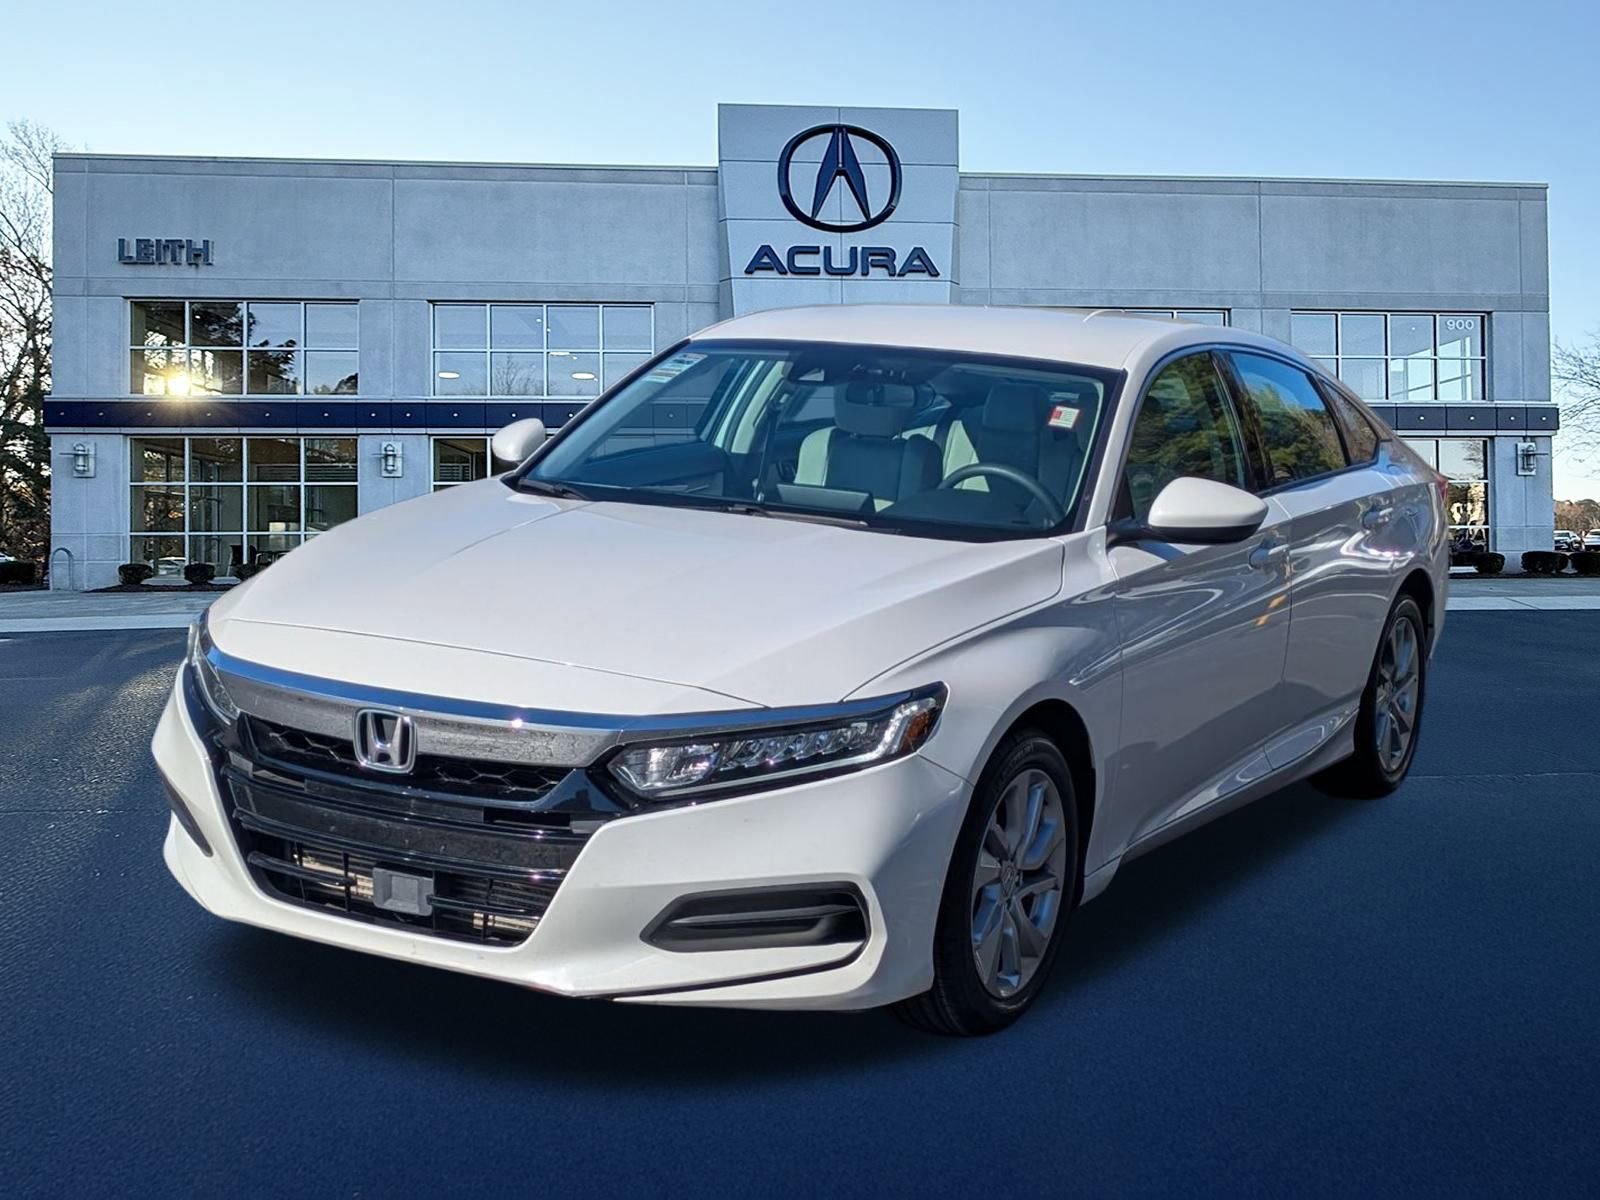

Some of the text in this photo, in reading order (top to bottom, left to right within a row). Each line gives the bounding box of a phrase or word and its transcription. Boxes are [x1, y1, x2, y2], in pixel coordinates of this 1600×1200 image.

[118, 238, 213, 265] LEITH
[744, 244, 940, 277] ACURA
[1446, 319, 1474, 330] 900
